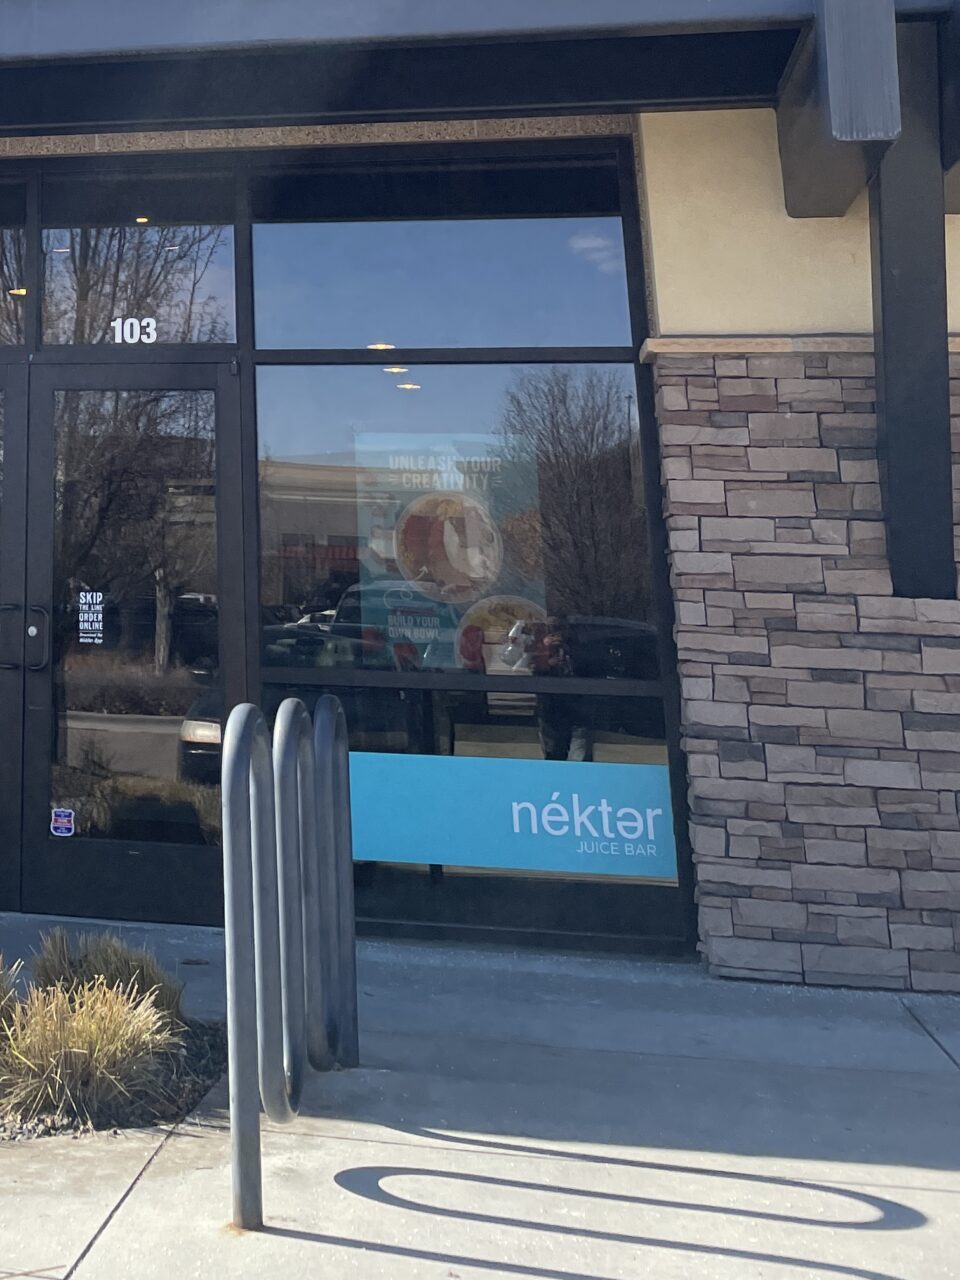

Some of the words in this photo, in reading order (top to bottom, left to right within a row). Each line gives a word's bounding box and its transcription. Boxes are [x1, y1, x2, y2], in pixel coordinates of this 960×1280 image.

[110, 317, 157, 344] 103
[389, 455, 457, 472] UNLEASH
[462, 457, 501, 473] YOUR
[402, 472, 489, 490] CREATIVITY
[79, 592, 103, 604] SKIP
[79, 613, 103, 622] ORDER
[79, 622, 104, 630] ONLINE
[511, 791, 663, 841] néktər
[576, 841, 621, 855] JUICE
[625, 842, 657, 857] BAR
